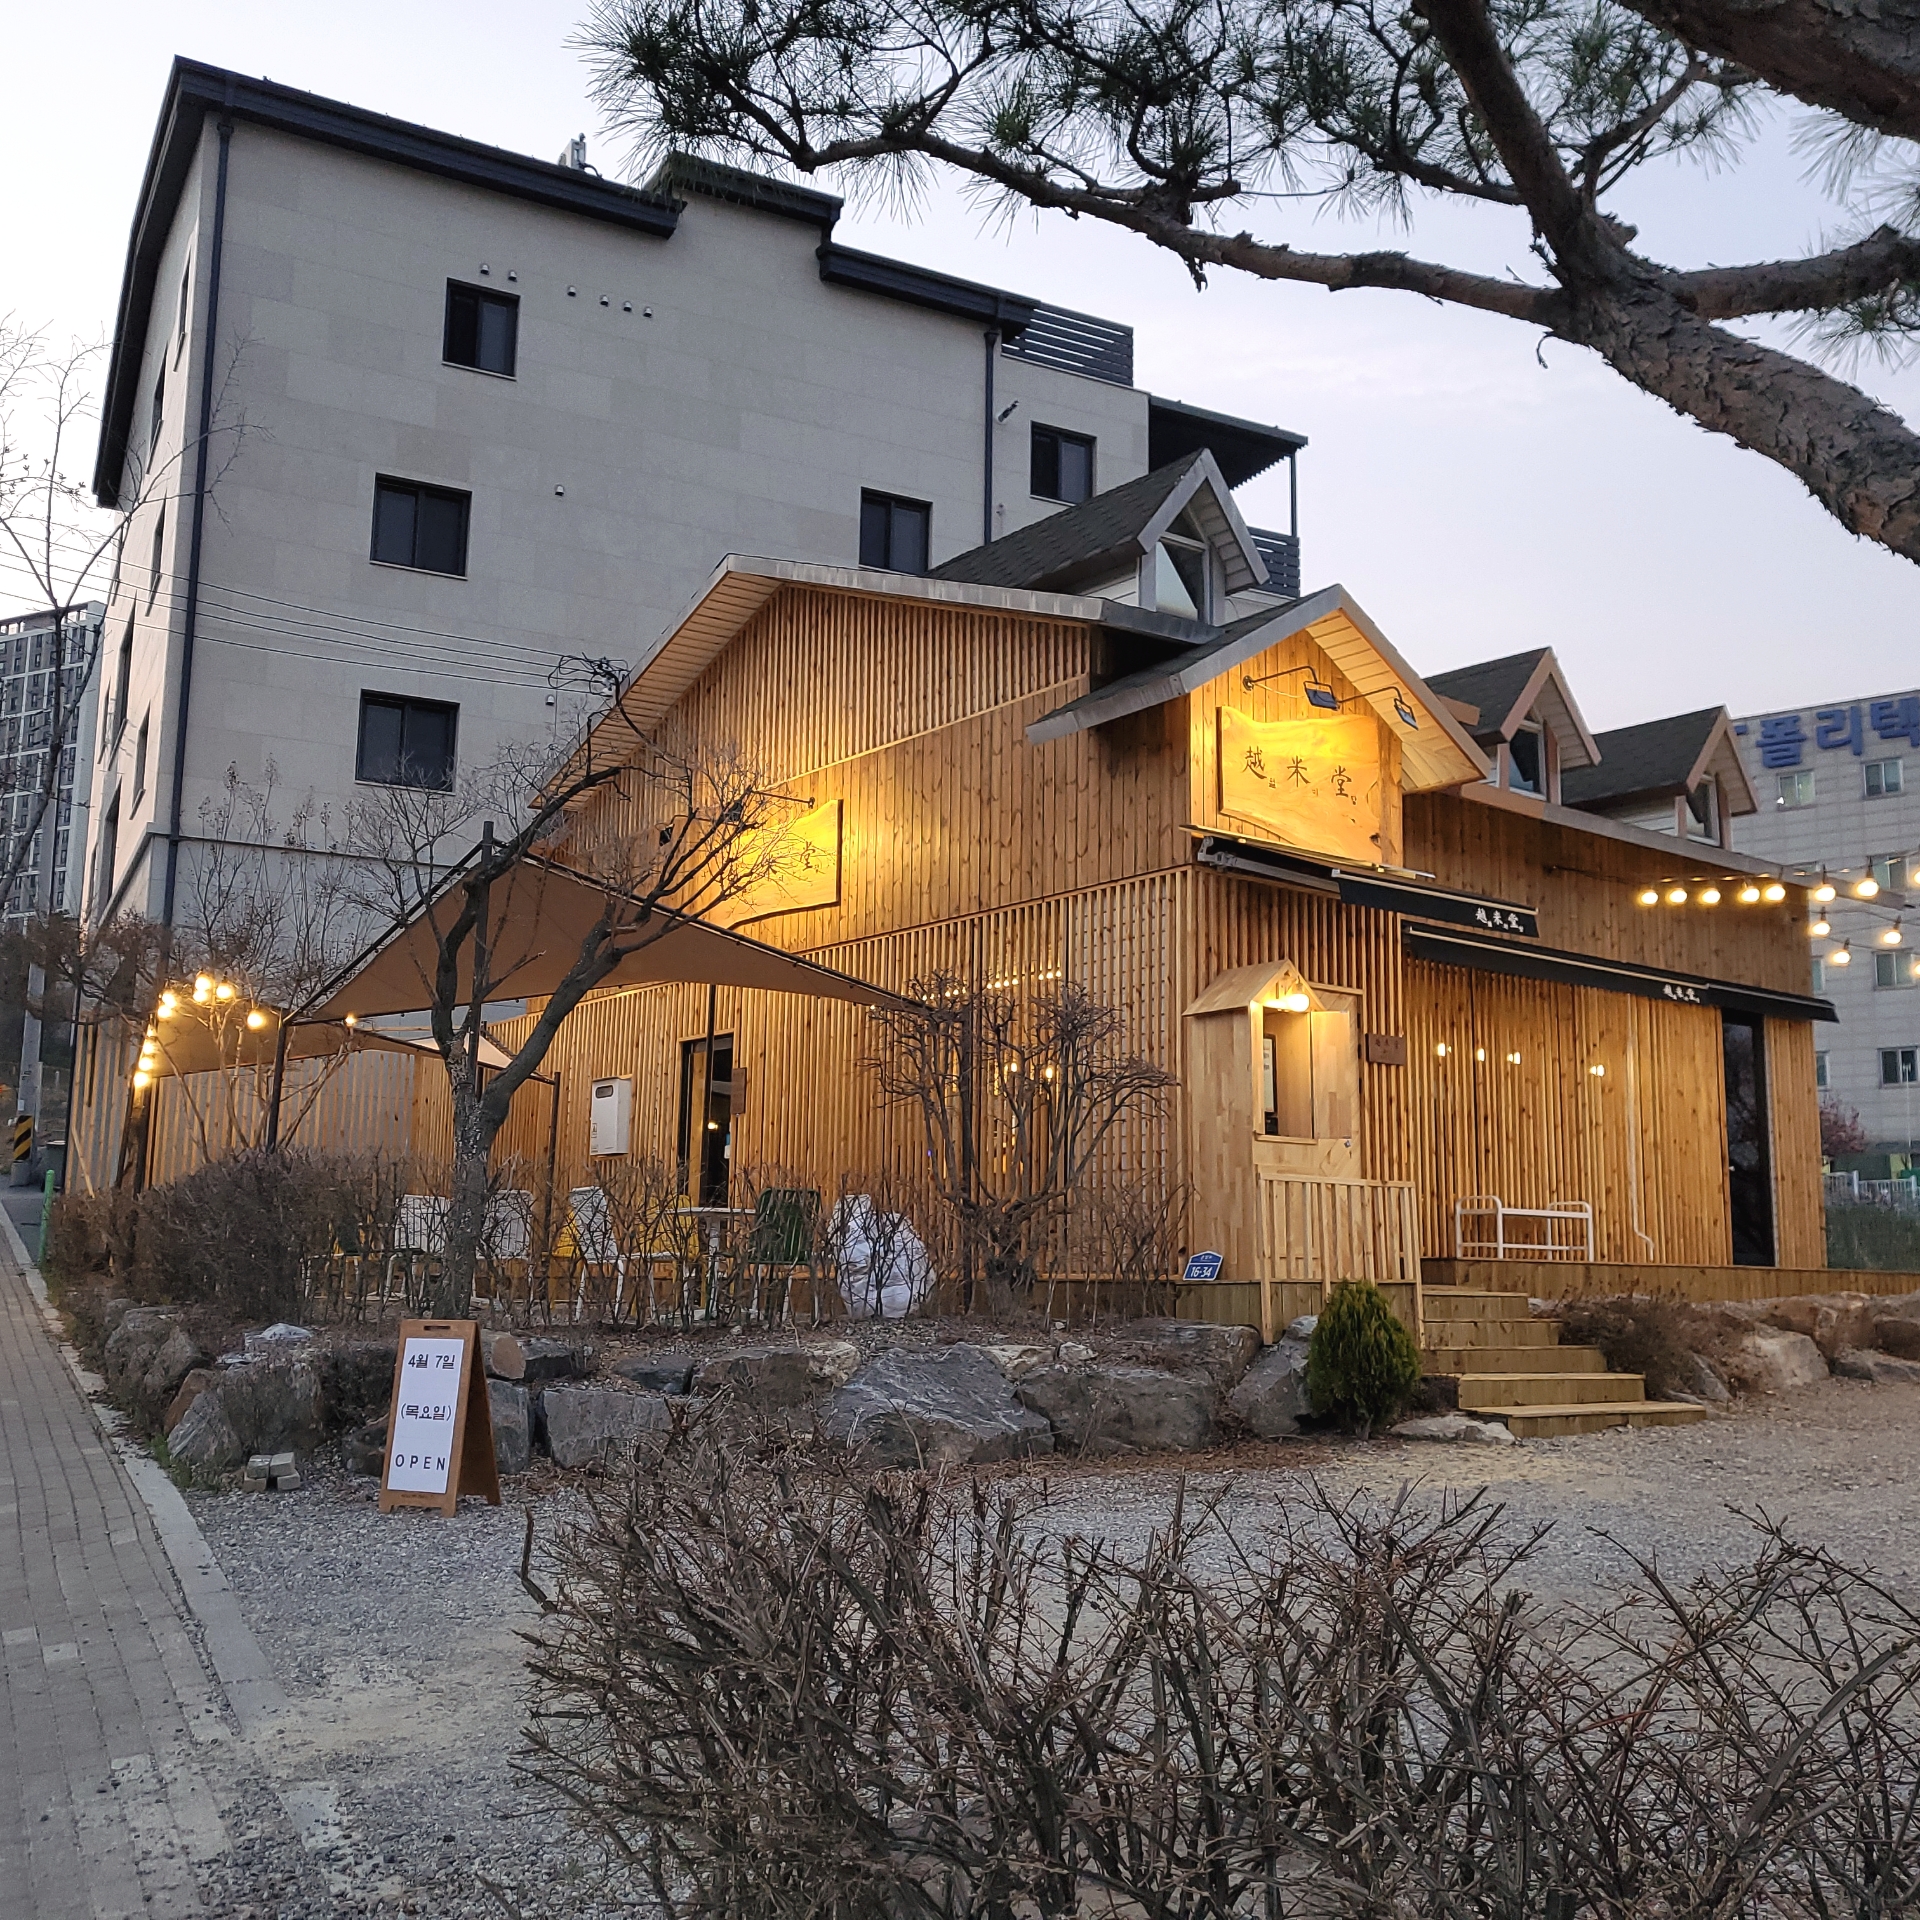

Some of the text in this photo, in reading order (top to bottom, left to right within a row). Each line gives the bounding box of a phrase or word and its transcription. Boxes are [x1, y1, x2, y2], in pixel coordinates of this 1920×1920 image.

[1190, 1266, 1213, 1278] 16-34
[407, 1353, 456, 1370] 4월 7일
[400, 1402, 452, 1422] (목요일)
[395, 1453, 446, 1471] OPEN
